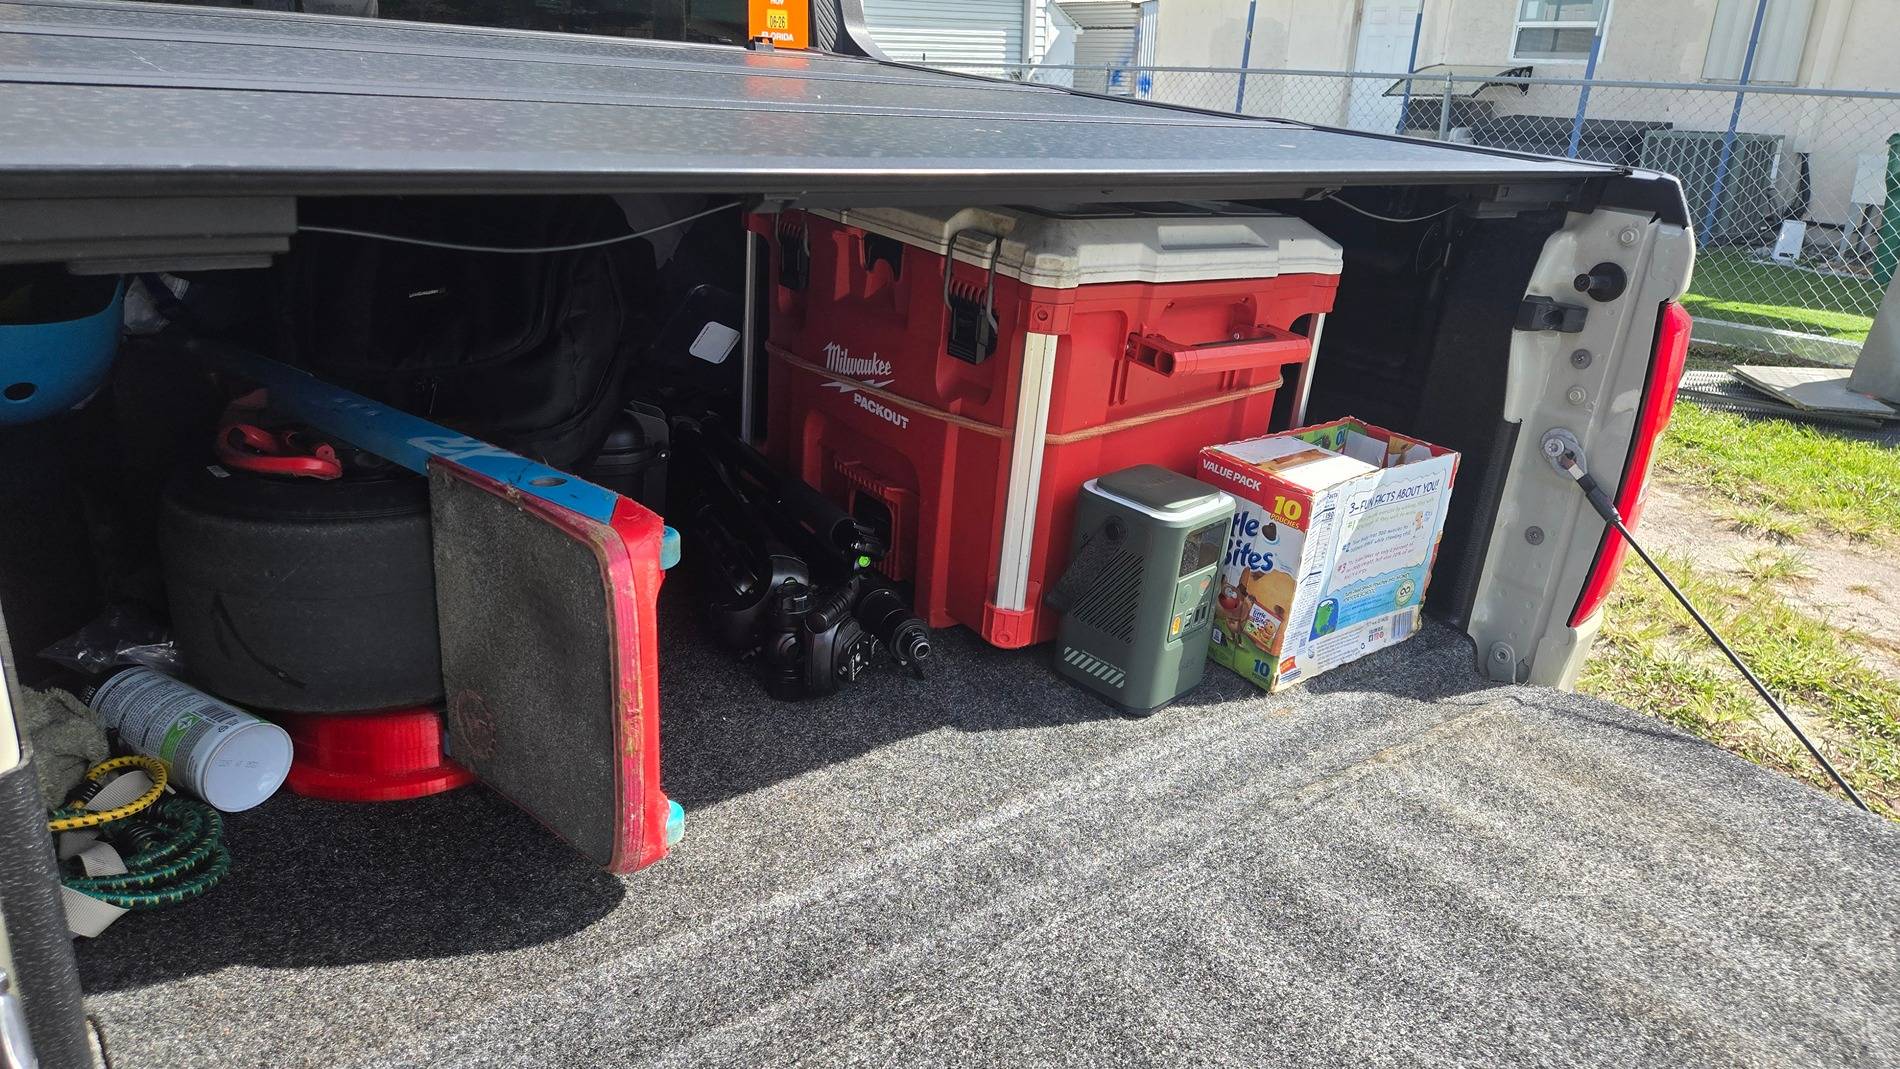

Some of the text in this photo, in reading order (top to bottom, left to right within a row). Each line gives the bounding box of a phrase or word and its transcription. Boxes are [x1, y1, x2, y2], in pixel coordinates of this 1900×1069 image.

[823, 341, 893, 376] Milwaukee
[853, 392, 909, 429] PACKOUT
[1203, 459, 1262, 491] VALUE PACK
[1374, 491, 1396, 505] FACTS
[1397, 484, 1422, 500] ABOUT
[1274, 496, 1302, 520] 10
[1230, 511, 1260, 537] tle
[1270, 513, 1300, 529] POUCHES
[1254, 658, 1271, 678] 10
